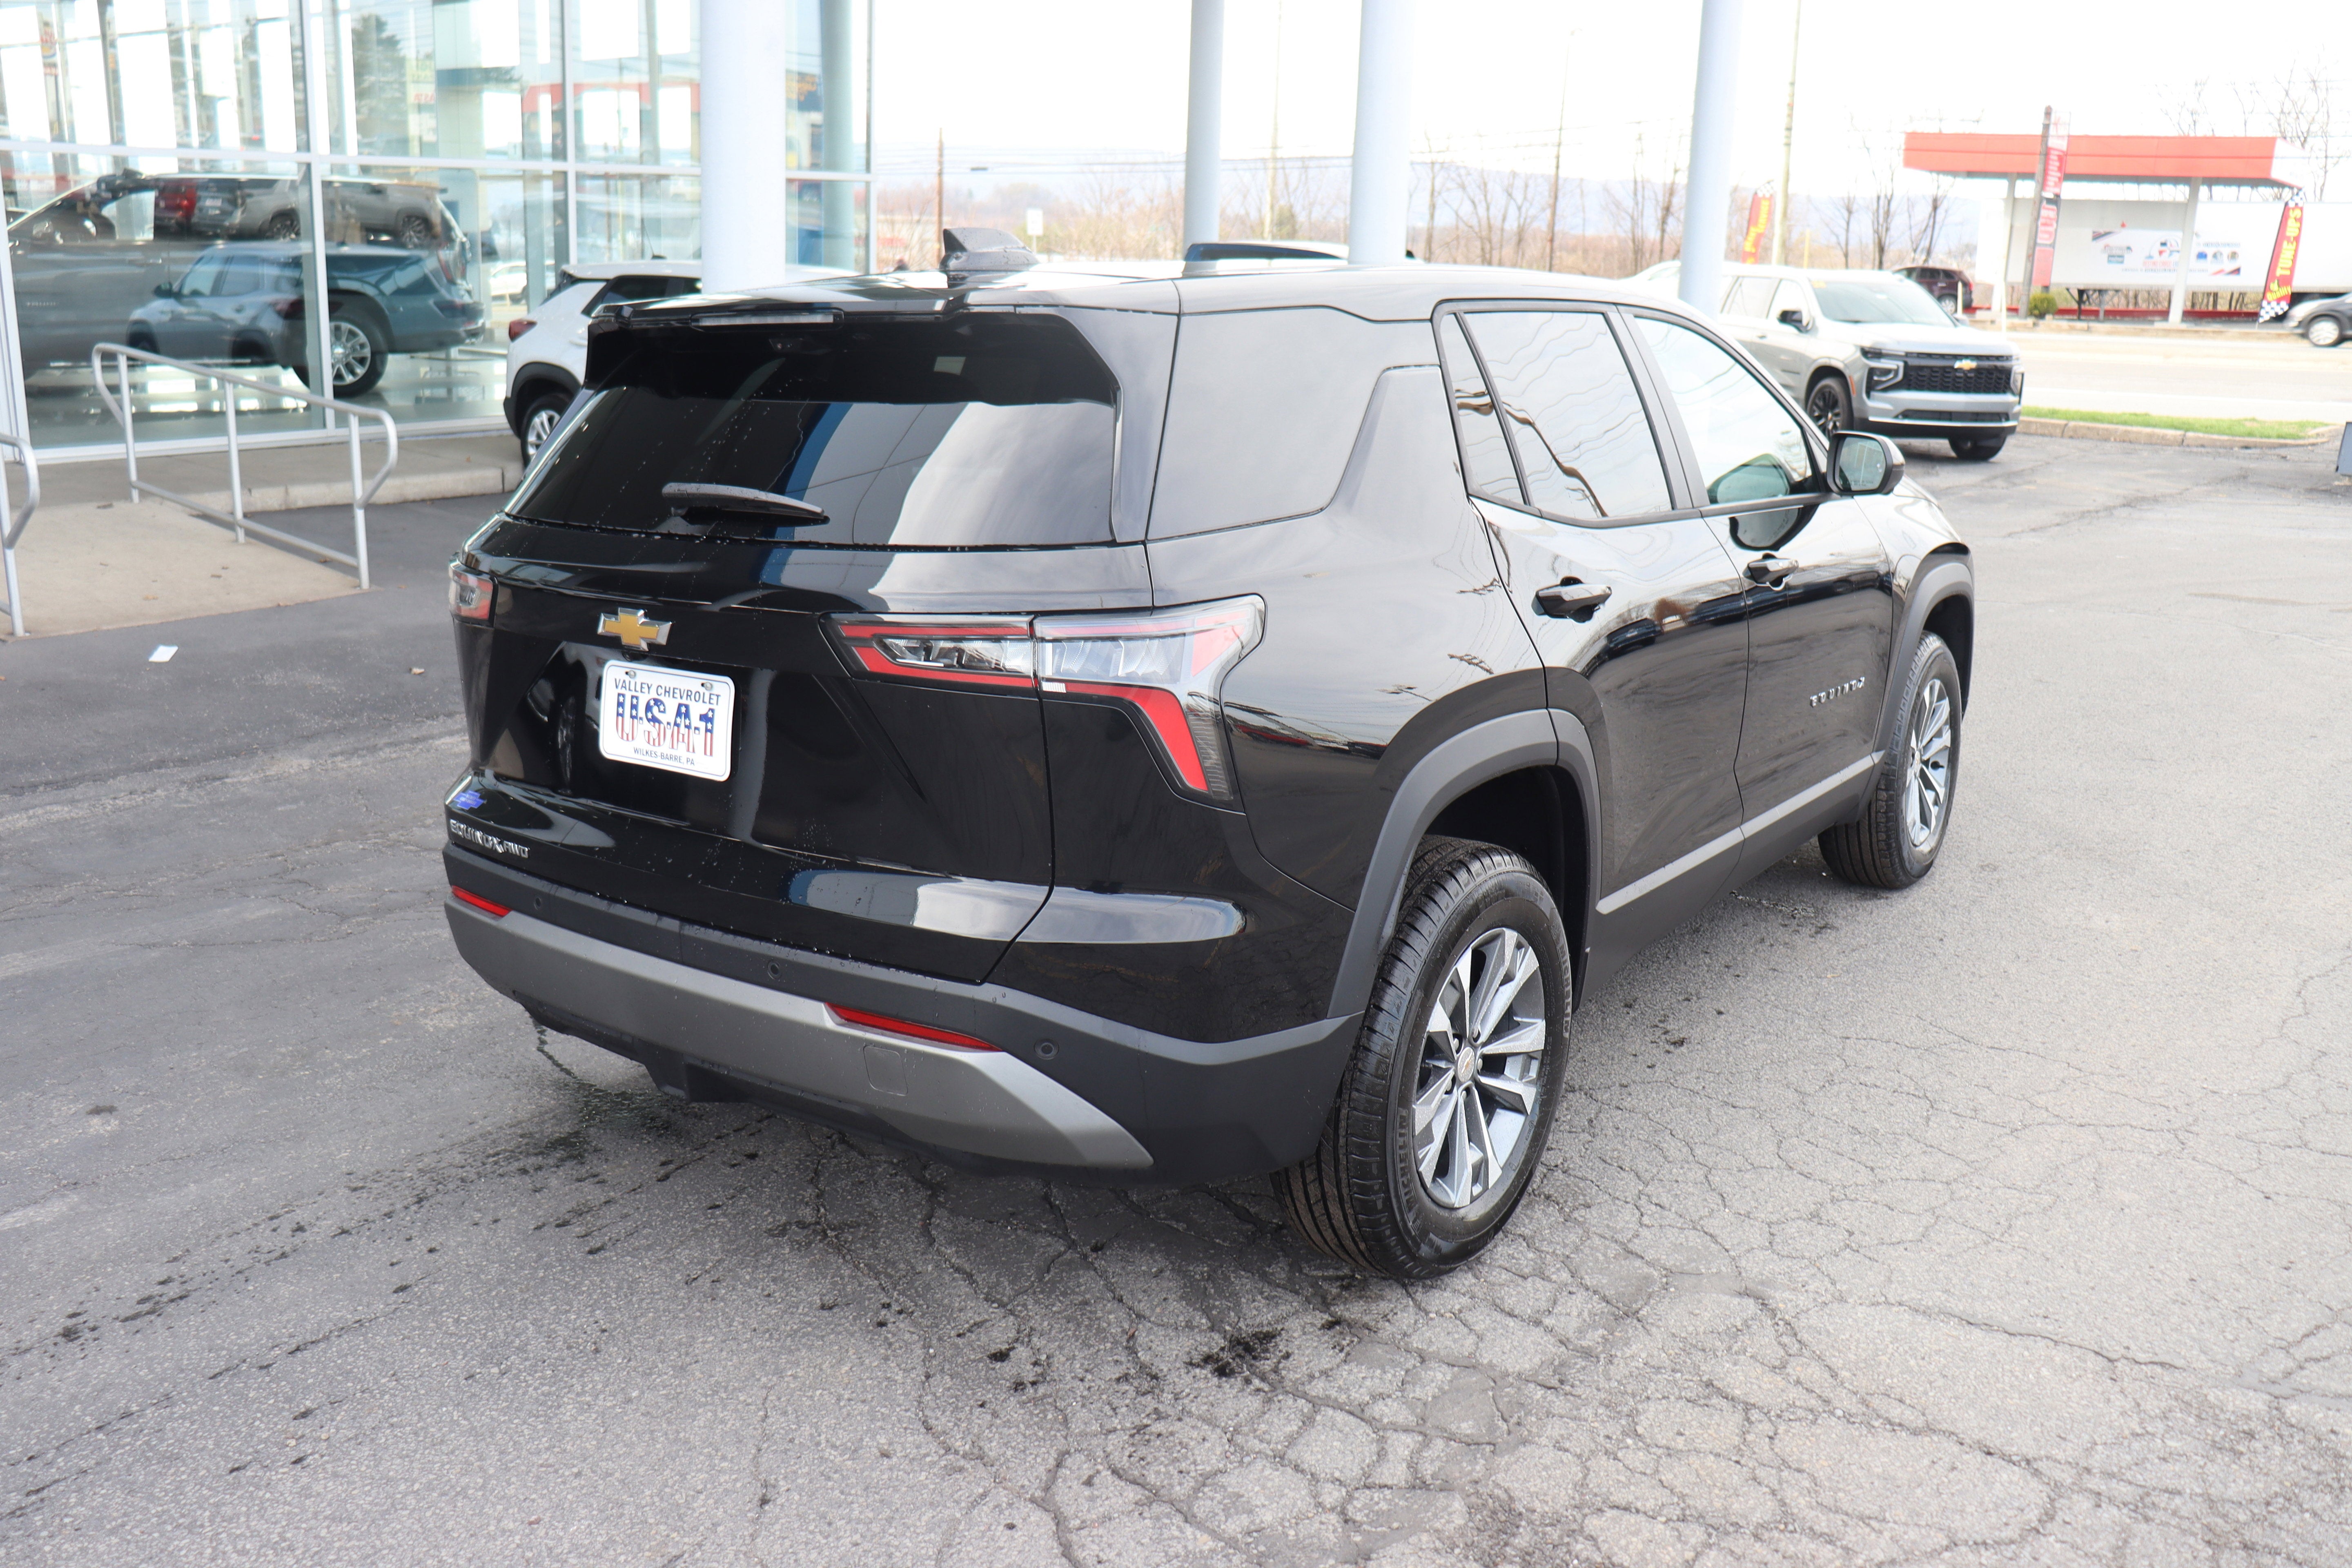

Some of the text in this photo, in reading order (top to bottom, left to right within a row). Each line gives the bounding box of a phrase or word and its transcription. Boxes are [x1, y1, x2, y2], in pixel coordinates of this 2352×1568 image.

[2276, 207, 2302, 276] TUNE-UPS
[614, 678, 722, 706] VALLEY CHEVROLET
[1810, 676, 1865, 708] EQUINOX
[633, 746, 695, 766] WILKES-BARRE, PA
[450, 819, 530, 859] EQUINOX AWD
[1558, 944, 1571, 1033] MICHELIN
[1398, 1114, 1418, 1213] MICHELIN
